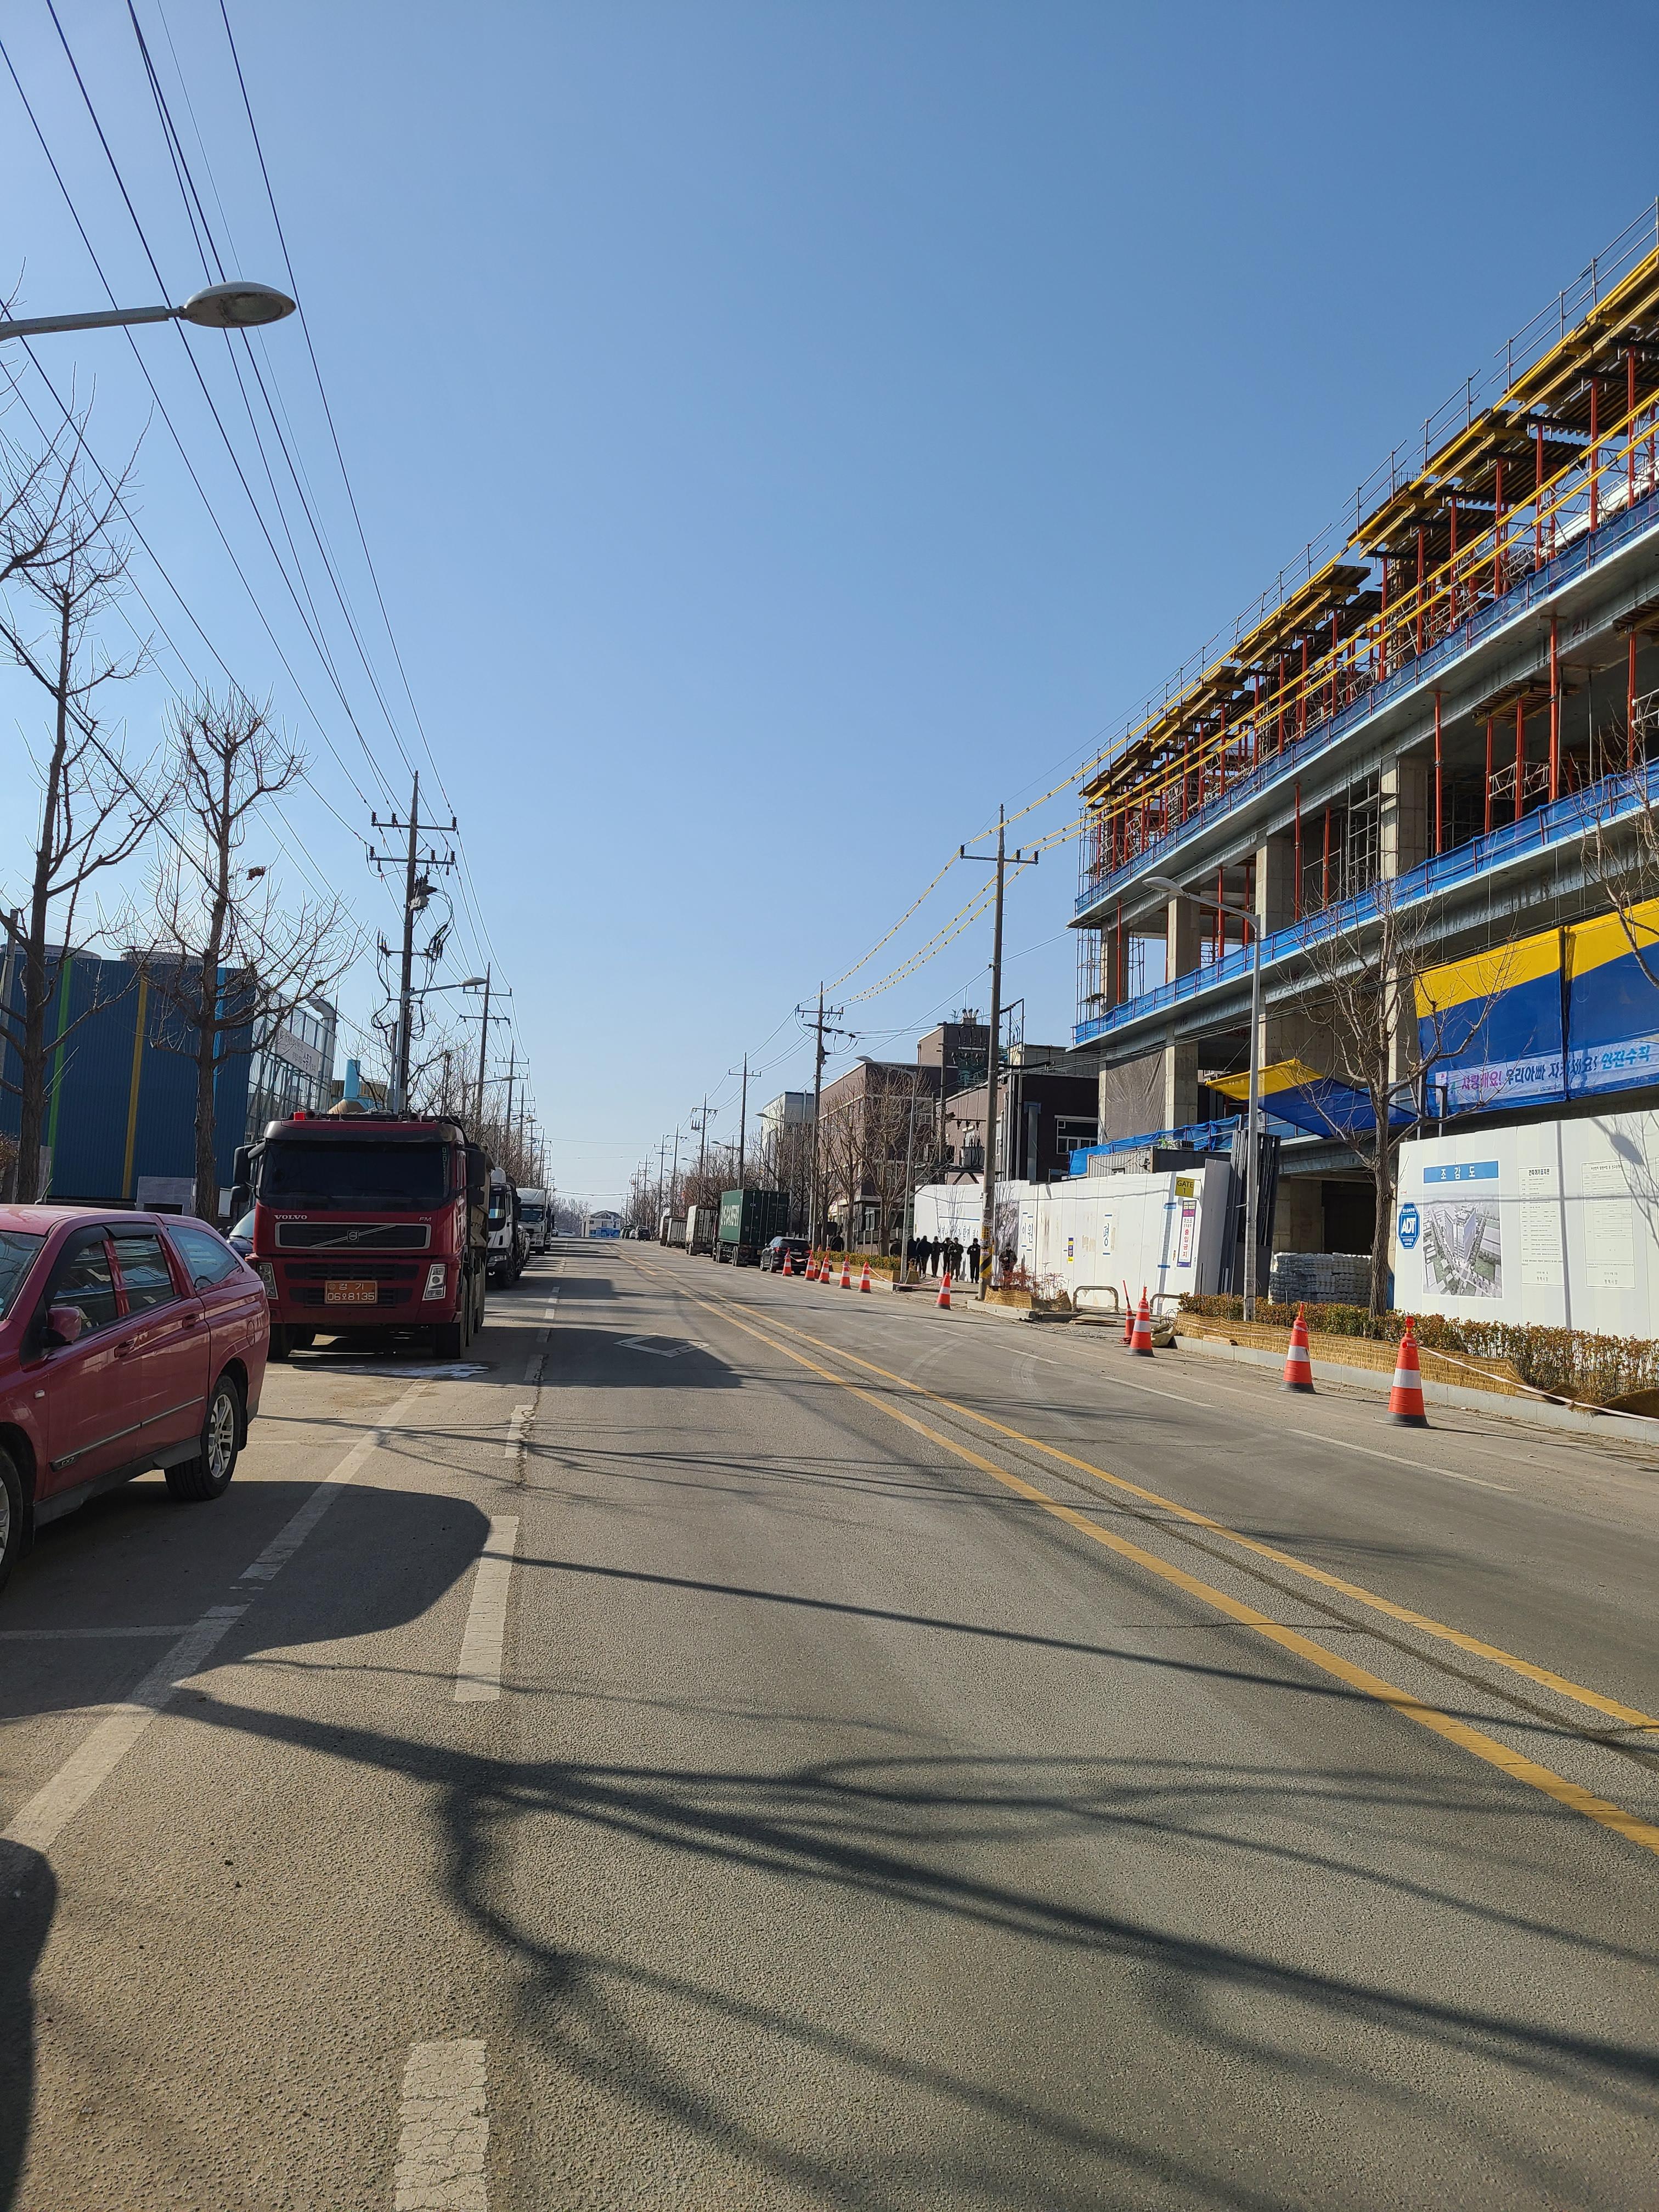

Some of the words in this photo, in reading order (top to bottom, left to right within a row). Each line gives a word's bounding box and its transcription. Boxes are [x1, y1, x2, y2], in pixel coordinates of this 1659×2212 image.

[1505, 1064, 1545, 1085] 우리아빠
[1548, 1056, 1598, 1079] 지세요!
[1440, 1166, 1476, 1180] 조감도
[1177, 1180, 1194, 1188] GATE
[1401, 1217, 1416, 1234] ADT
[1182, 1228, 1190, 1258] 출입금지
[327, 1292, 375, 1301] 06오8135
